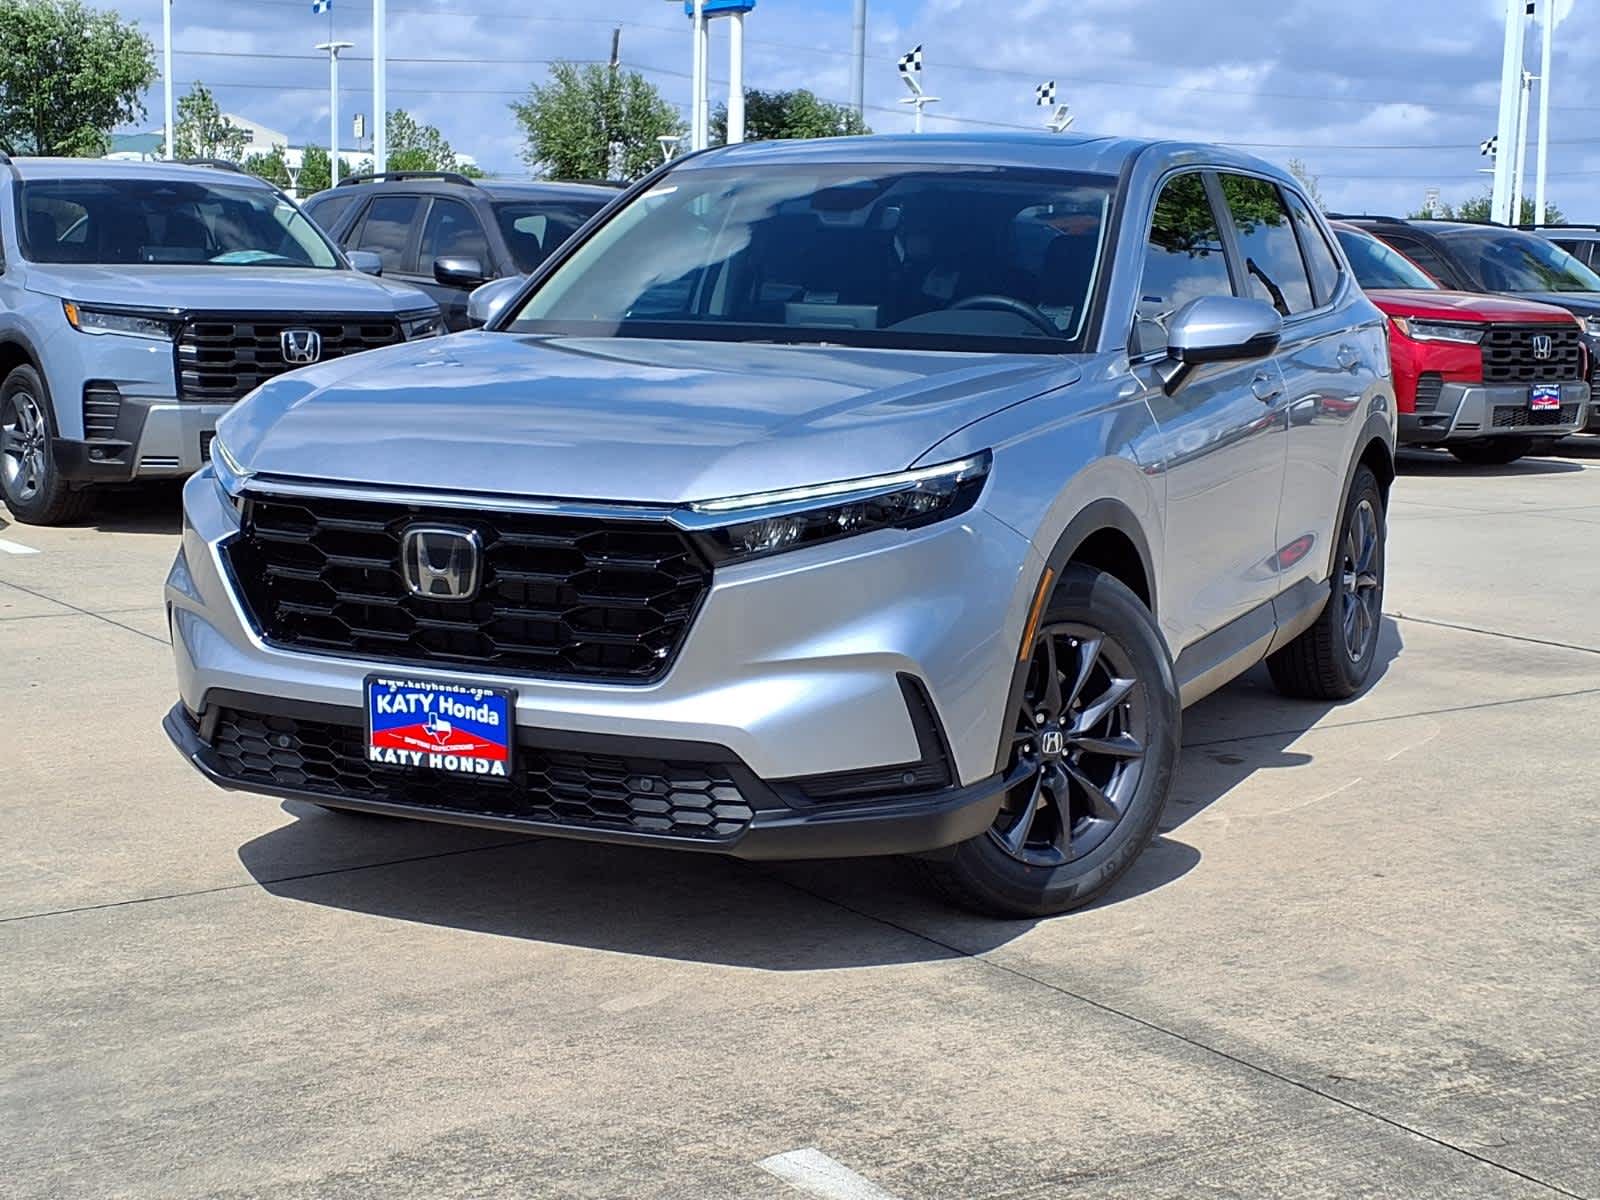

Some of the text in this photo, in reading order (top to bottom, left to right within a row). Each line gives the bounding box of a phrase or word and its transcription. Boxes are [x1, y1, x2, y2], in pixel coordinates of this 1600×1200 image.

[378, 678, 493, 696] www.katyhonda.com
[377, 694, 499, 725] KATY Honda
[370, 746, 505, 775] KATY HONDA
